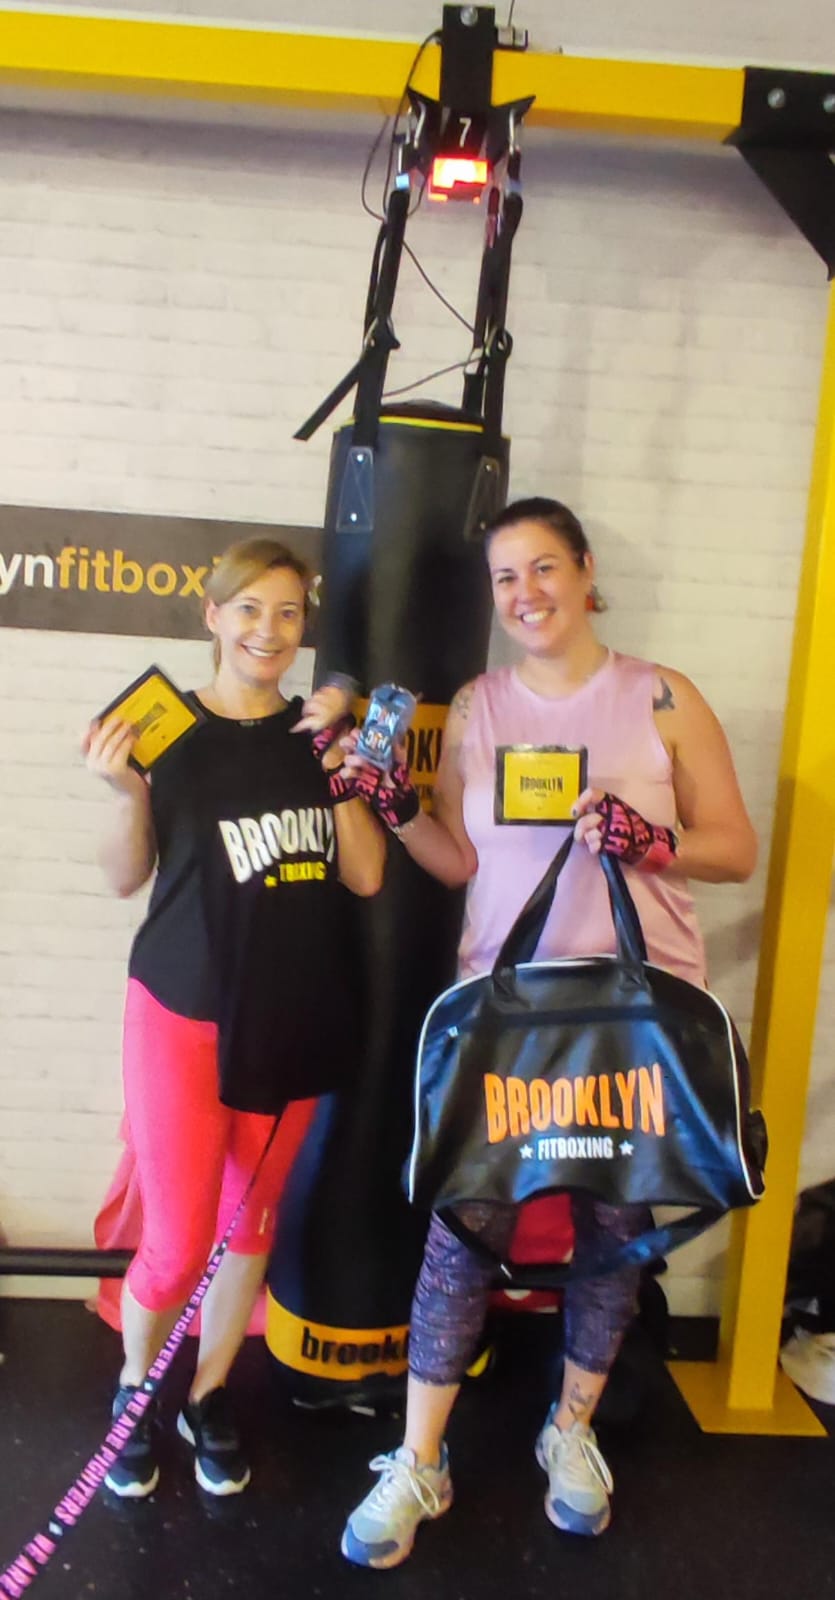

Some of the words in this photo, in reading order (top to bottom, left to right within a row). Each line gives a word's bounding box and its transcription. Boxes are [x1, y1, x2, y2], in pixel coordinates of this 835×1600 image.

[459, 117, 472, 148] 7
[0, 546, 222, 598] ynfitbox
[519, 775, 564, 794] BROOKLYN
[484, 1062, 665, 1144] BROOKLYN
[538, 1136, 614, 1161] FITBOXING
[189, 1275, 212, 1306] ARE
[148, 1304, 197, 1381] FIGHTERS
[125, 1391, 151, 1417] WE
[105, 1412, 137, 1450] ARE
[54, 1444, 118, 1527] FIGHTERS
[25, 1532, 57, 1565] WE
